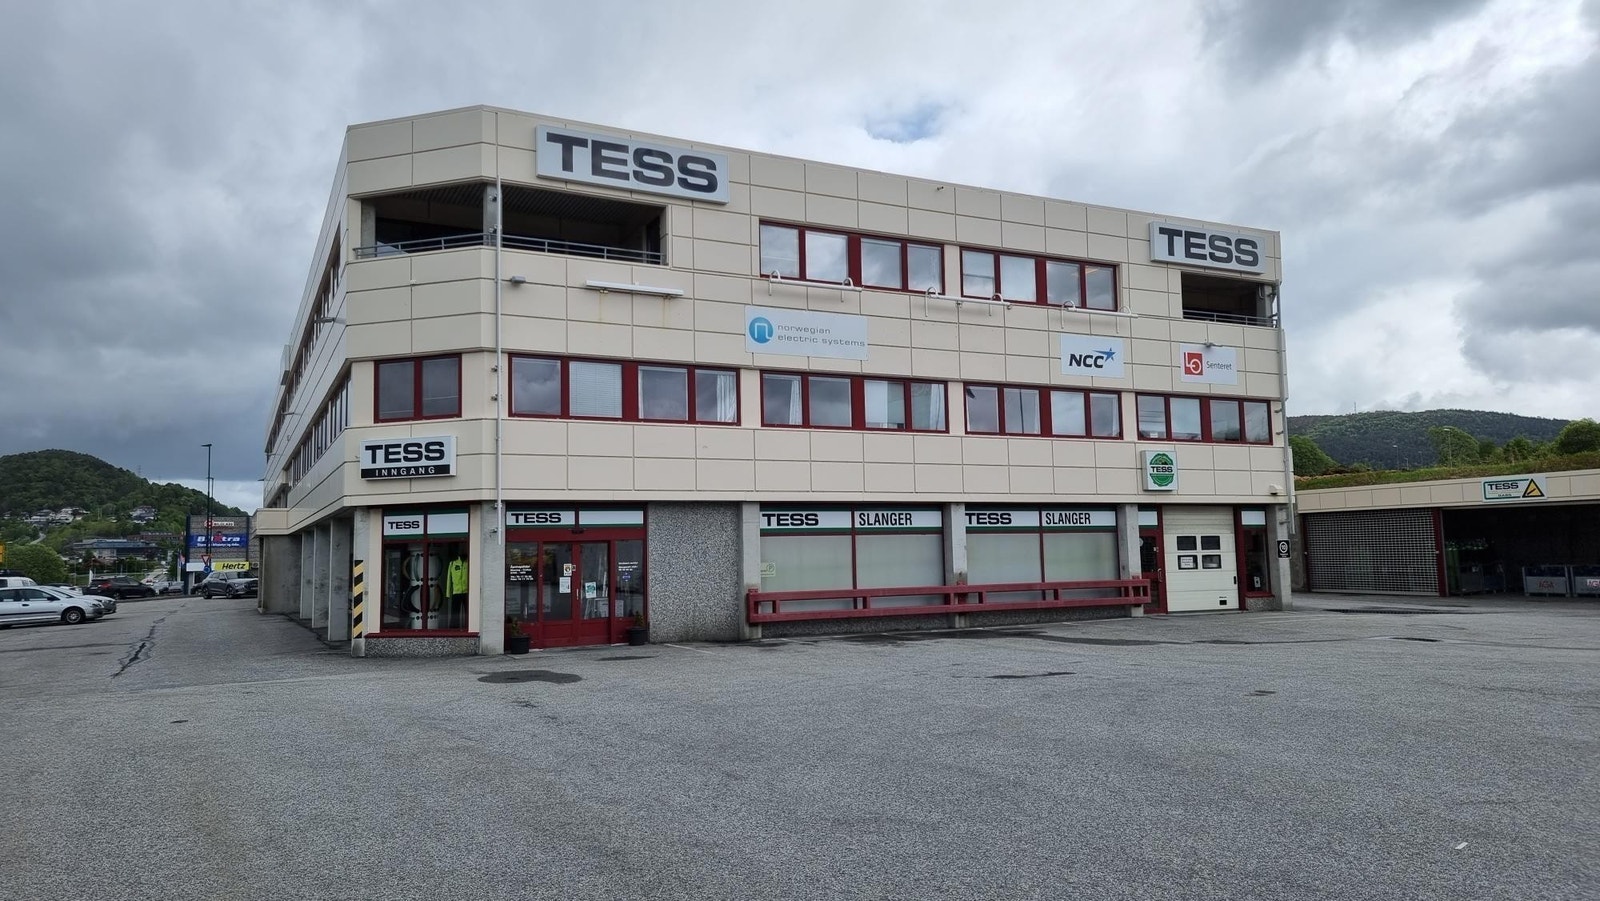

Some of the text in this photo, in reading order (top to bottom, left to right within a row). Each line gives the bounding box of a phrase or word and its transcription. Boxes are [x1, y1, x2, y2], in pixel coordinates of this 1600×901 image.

[546, 131, 718, 193] TESS
[1158, 226, 1259, 267] TESS
[777, 324, 831, 335] norwegian
[777, 334, 865, 347] electric systems
[1068, 353, 1105, 369] NCC
[1206, 361, 1232, 371] Senteret
[364, 441, 445, 464] TESS
[375, 466, 436, 477] INNGANG
[1487, 482, 1519, 490] TESS
[387, 520, 420, 529] TESS
[510, 512, 562, 524] TESS
[762, 512, 819, 526] TESS
[858, 512, 913, 526] SLANGER
[965, 512, 1012, 525] TESS
[1045, 512, 1091, 525] SLANGER
